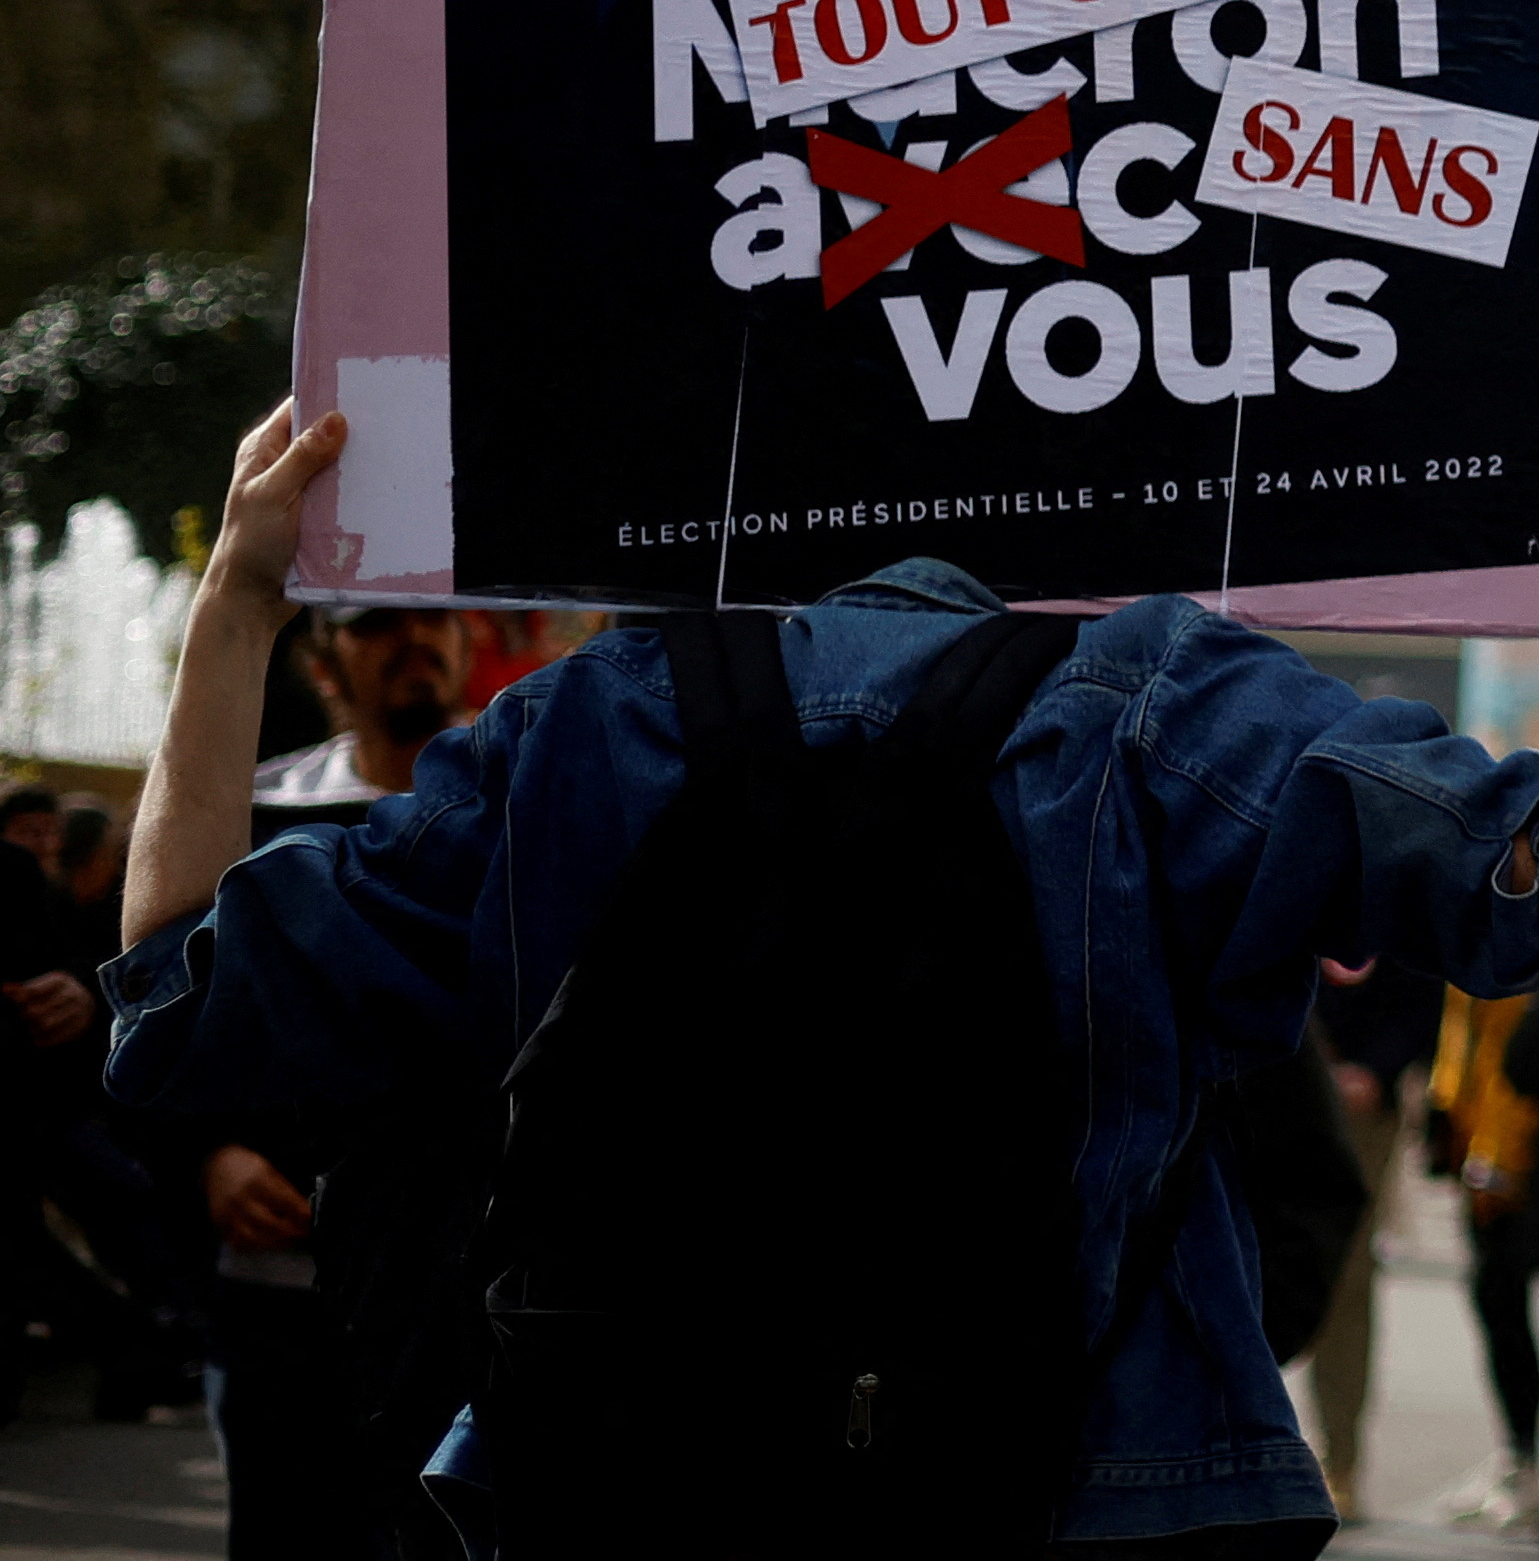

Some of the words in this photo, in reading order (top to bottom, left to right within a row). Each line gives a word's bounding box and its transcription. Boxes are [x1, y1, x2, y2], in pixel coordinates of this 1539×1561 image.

[1231, 100, 1498, 228] SANS
[880, 257, 1398, 422] vous
[618, 511, 789, 547] ÉLECTION
[807, 487, 1094, 530] PRÉSIDENTIELLE
[1143, 481, 1179, 505] 10
[1198, 476, 1235, 500] ET
[1256, 471, 1293, 494] 24
[1311, 462, 1407, 491] AVRIL
[1425, 455, 1505, 481] 2022
